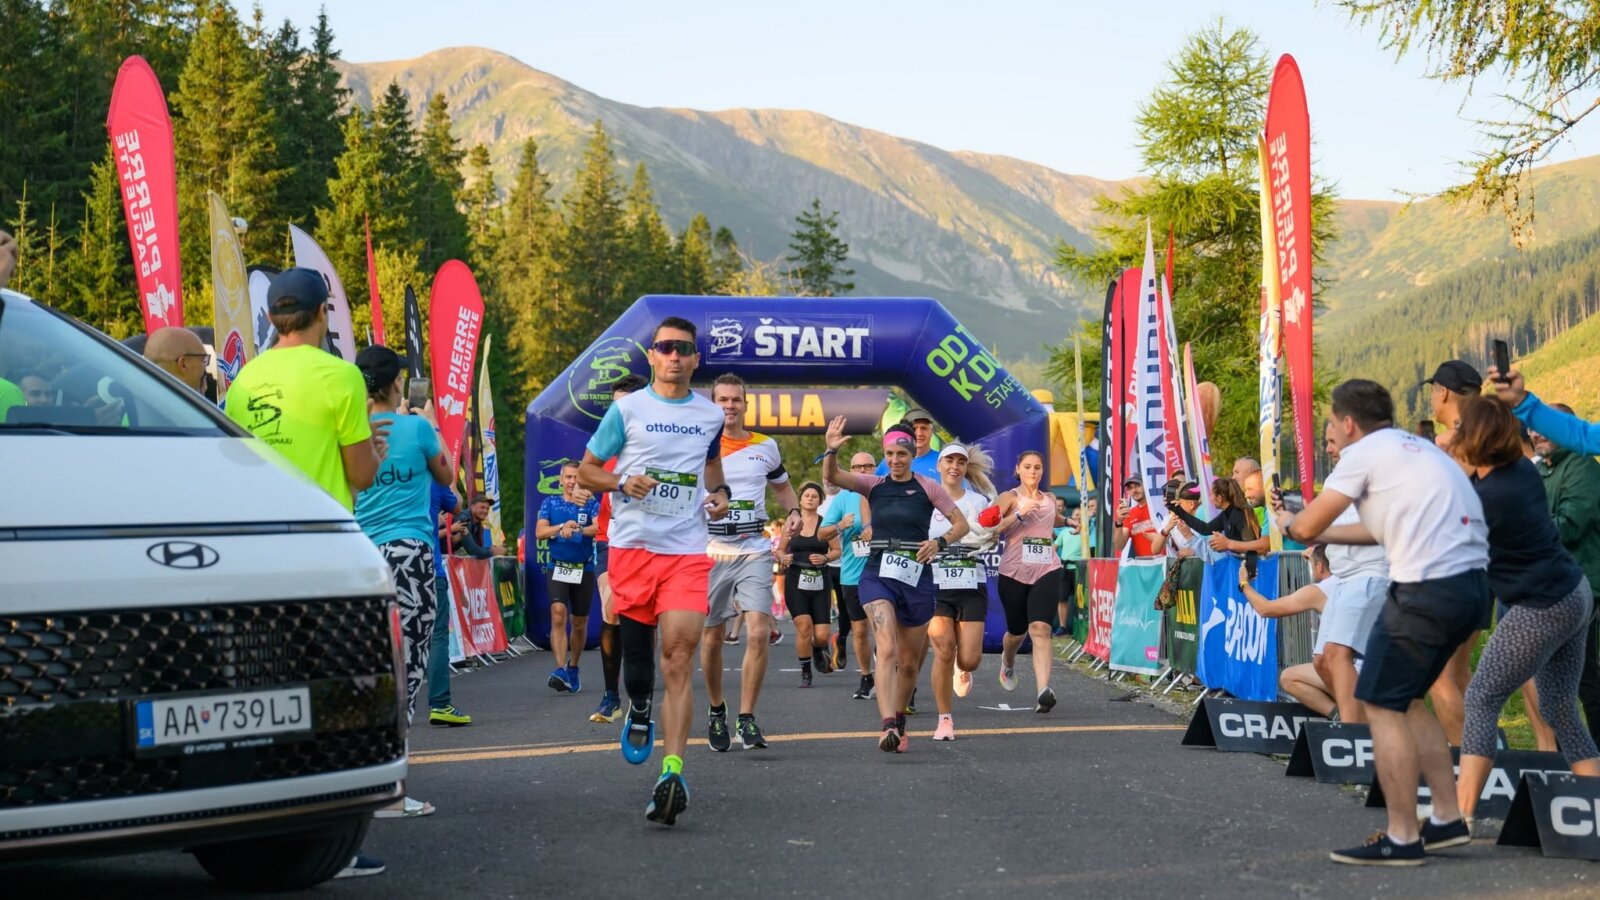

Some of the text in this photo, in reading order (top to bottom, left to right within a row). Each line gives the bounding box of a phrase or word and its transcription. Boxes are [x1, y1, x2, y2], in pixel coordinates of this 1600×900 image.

[447, 305, 472, 390] PIERRE
[754, 317, 869, 359] ŠTART
[459, 311, 480, 394] BAGUETTE
[926, 334, 969, 377] OD
[949, 367, 983, 402] K
[744, 393, 826, 427] ILLA
[645, 422, 706, 436] ottobock.
[652, 484, 693, 501] 180 1
[726, 511, 752, 521] 45 1
[1028, 545, 1044, 554] 183
[558, 567, 573, 576] 307
[886, 555, 919, 574] 046 1
[944, 568, 975, 578] 187 1
[802, 576, 817, 584] 201
[164, 705, 200, 737] AA
